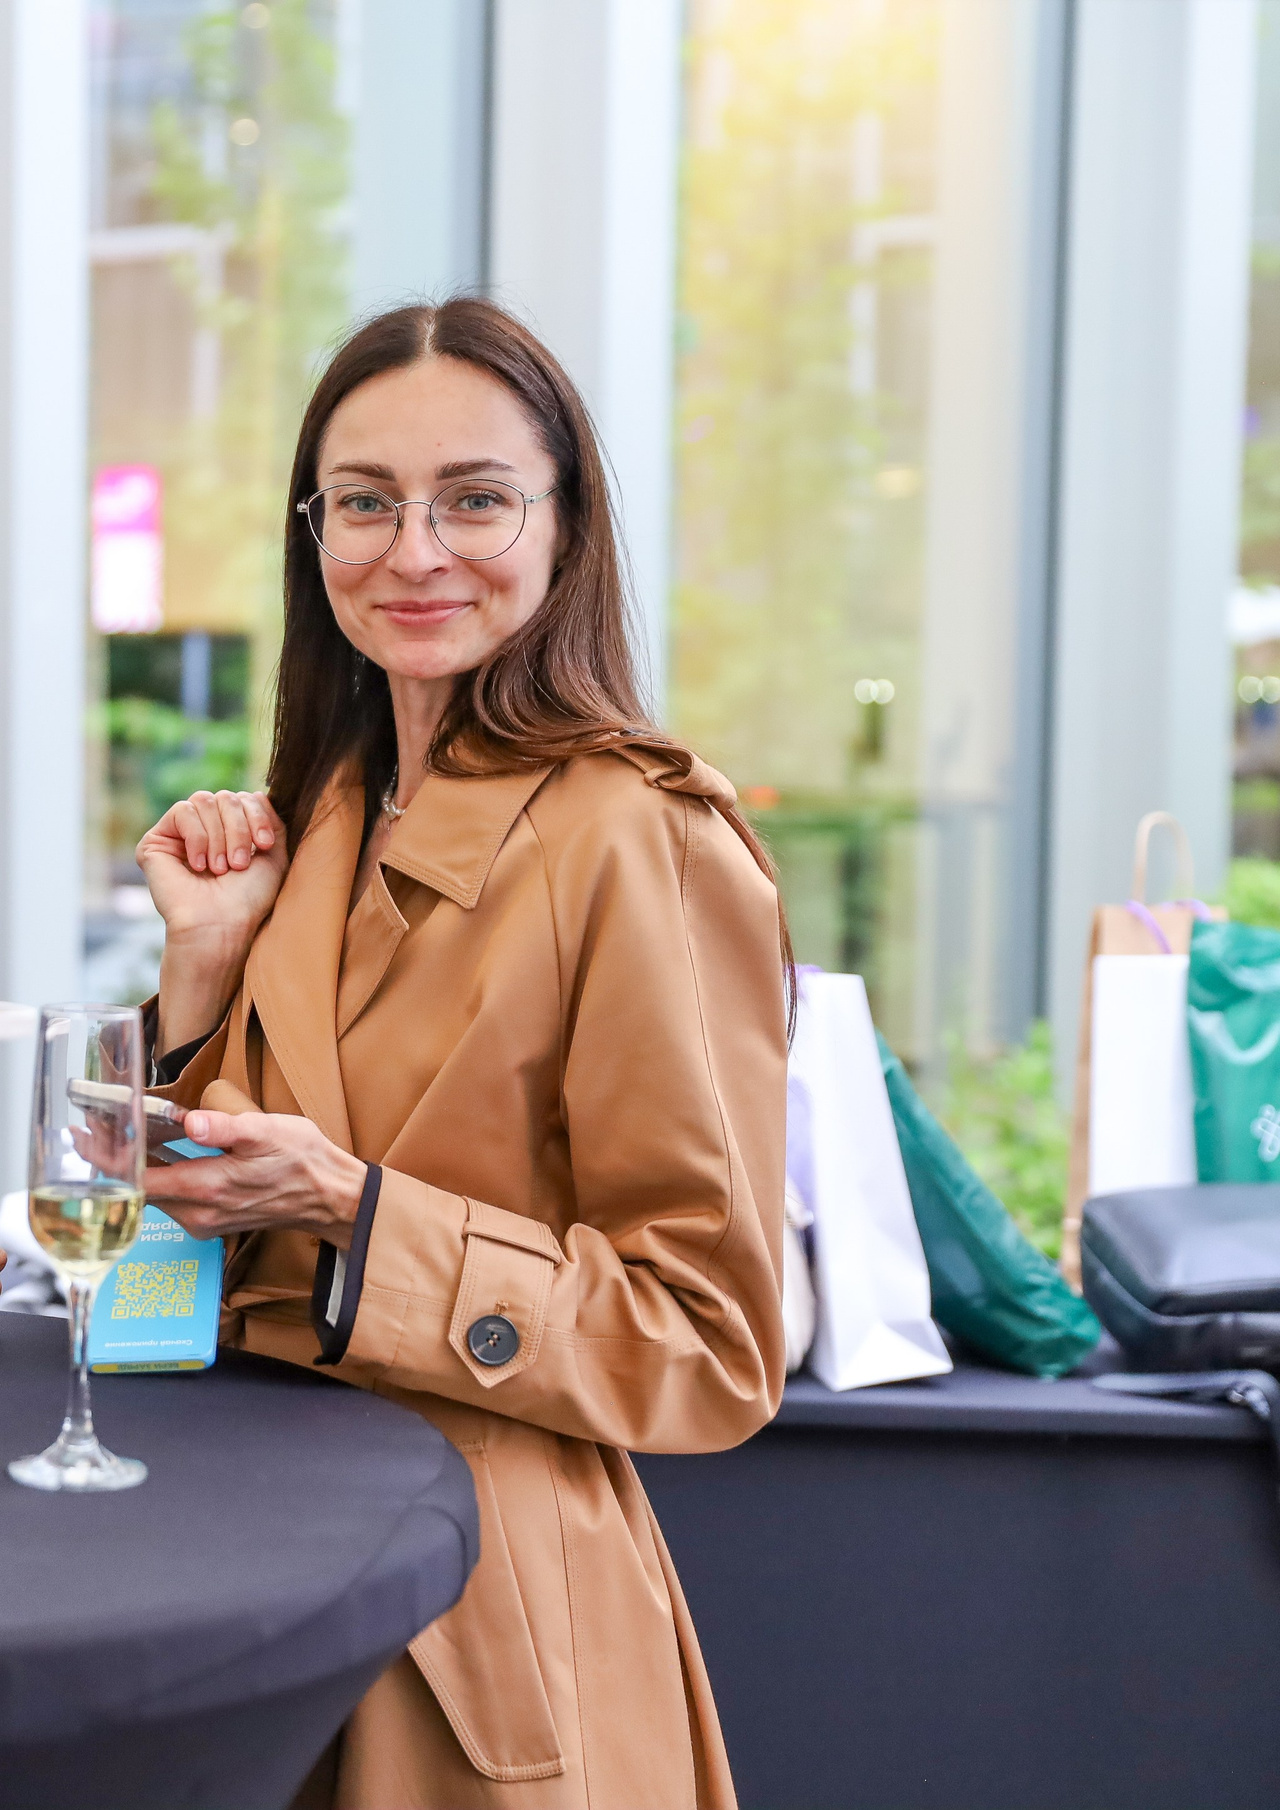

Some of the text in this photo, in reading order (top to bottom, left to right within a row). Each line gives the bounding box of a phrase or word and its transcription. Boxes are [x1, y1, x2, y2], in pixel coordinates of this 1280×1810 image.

[141, 1220, 181, 1231] аряд
[140, 1231, 185, 1242] Бери
[104, 1339, 193, 1348] Скачай приложение
